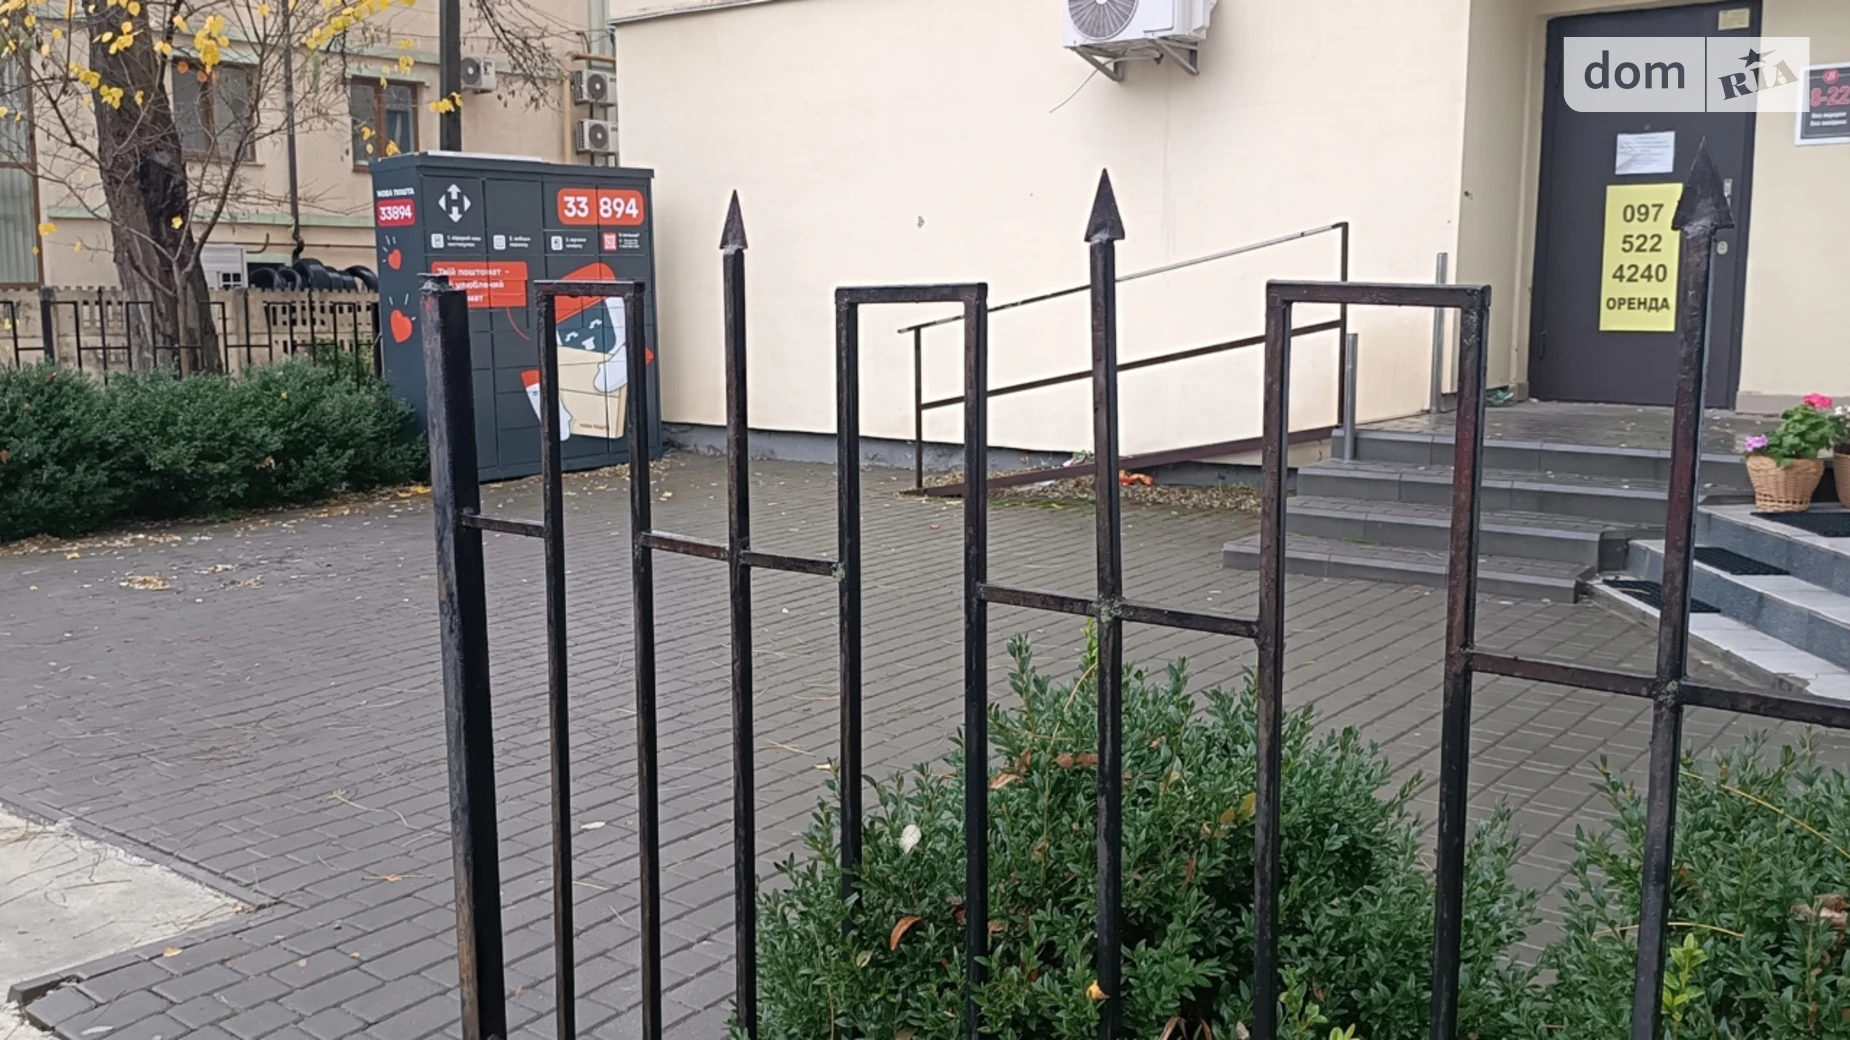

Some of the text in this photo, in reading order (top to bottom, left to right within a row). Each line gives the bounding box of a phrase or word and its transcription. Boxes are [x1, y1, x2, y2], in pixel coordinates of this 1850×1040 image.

[379, 204, 412, 221] 33894
[563, 196, 639, 219] 33 894
[1622, 203, 1665, 223] 097
[1621, 234, 1662, 253] 522
[1612, 264, 1668, 283] 4240
[1606, 297, 1670, 312] ОРЕНДА
